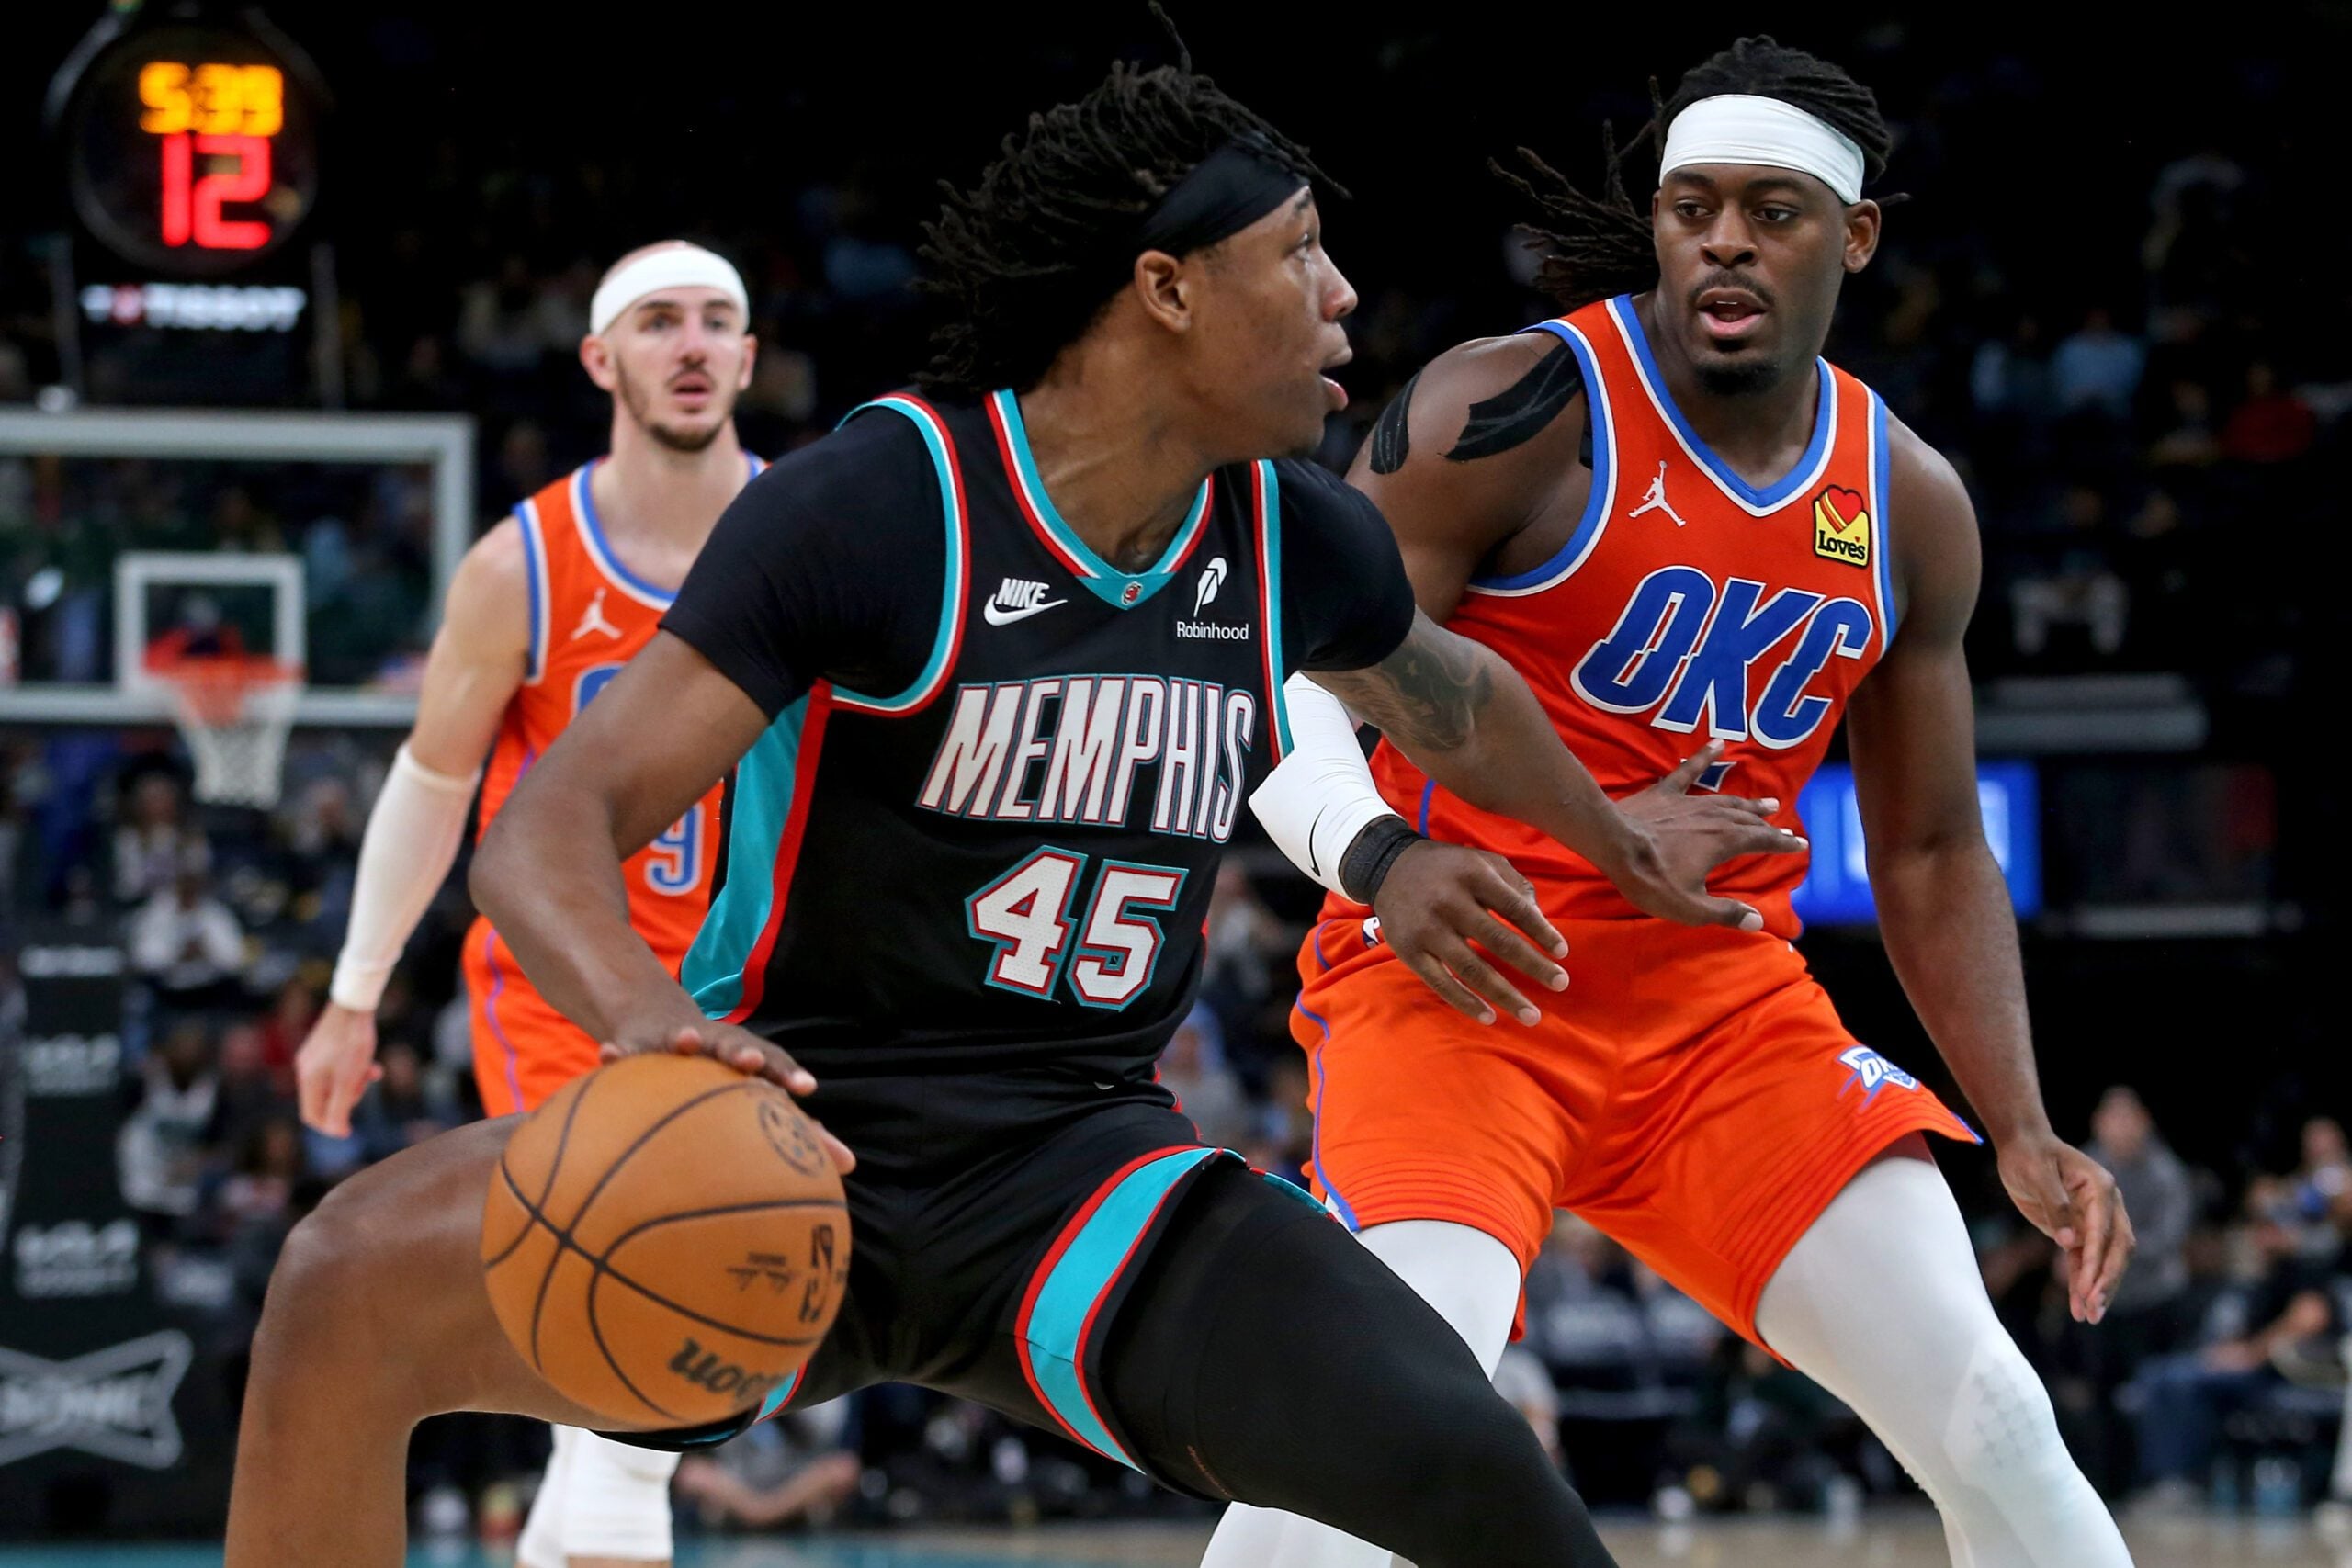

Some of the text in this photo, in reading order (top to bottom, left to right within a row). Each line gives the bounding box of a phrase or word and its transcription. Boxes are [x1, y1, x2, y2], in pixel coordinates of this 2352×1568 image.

[162, 133, 272, 249] 12
[995, 577, 1050, 610] NIKE
[1176, 620, 1250, 640] Robinhood
[1570, 565, 1873, 750] OKC
[915, 673, 1256, 844] MEMPHIS
[964, 845, 1190, 1012] 45
